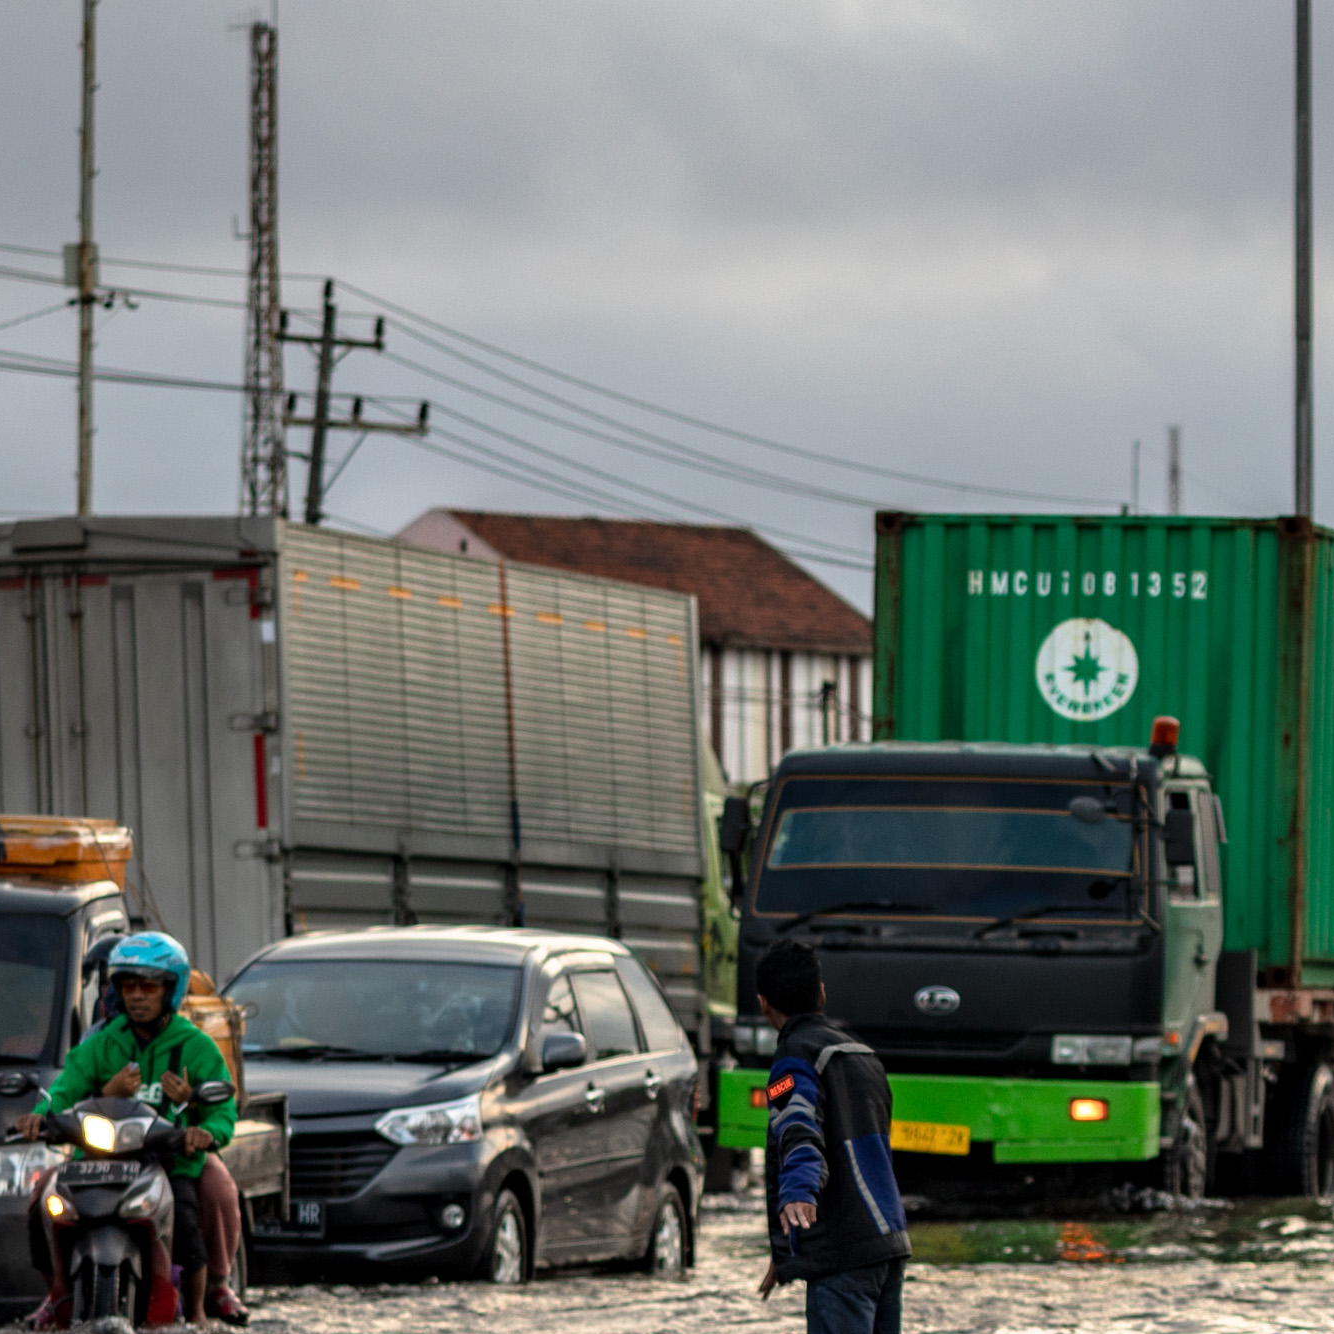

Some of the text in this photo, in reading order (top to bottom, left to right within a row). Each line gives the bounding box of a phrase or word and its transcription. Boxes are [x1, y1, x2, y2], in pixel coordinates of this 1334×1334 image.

[1043, 672, 1130, 715] EVERGREEN
[769, 1078, 793, 1098] RESCUE
[298, 1201, 320, 1225] HR
